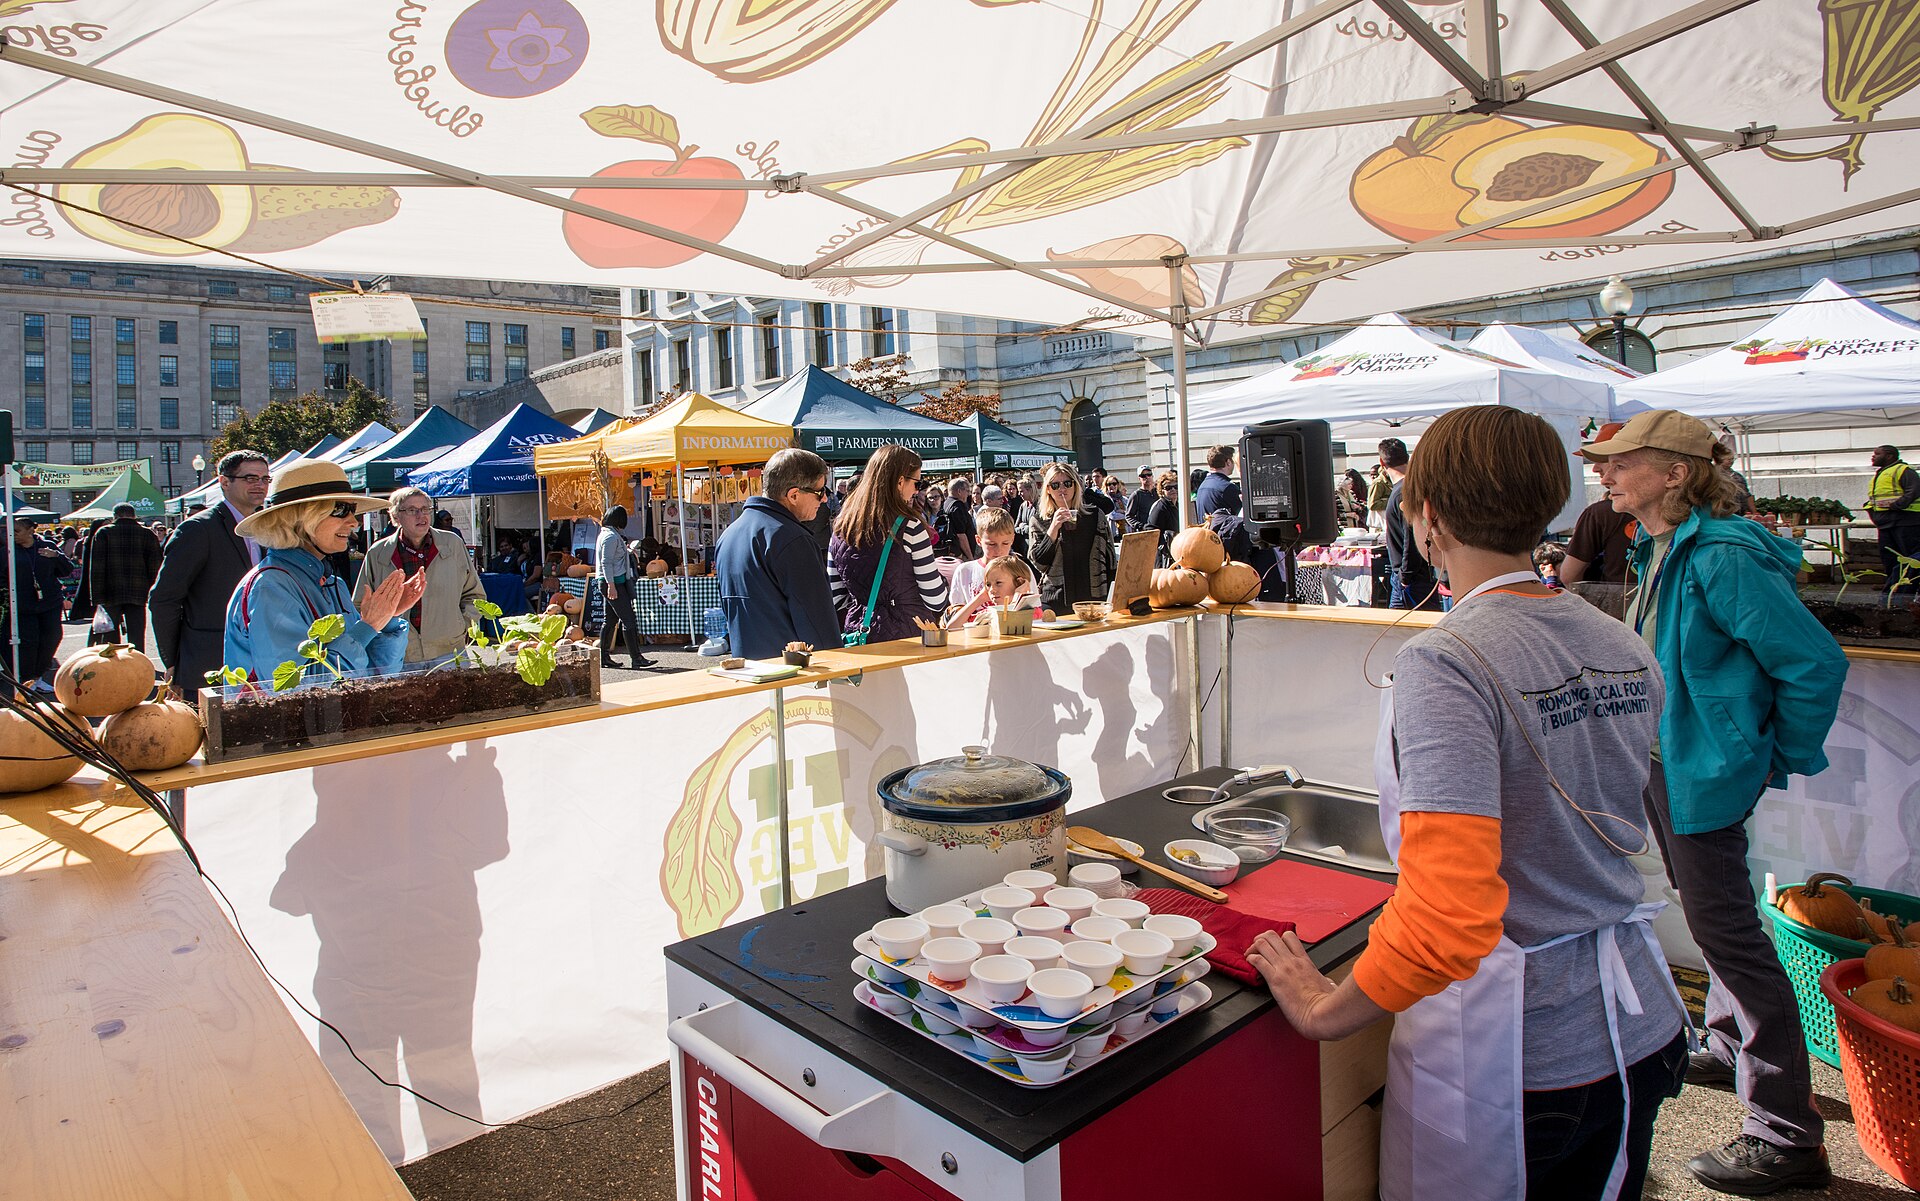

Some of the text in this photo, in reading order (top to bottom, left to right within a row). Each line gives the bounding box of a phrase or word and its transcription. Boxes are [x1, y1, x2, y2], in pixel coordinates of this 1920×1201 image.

[1815, 339, 1920, 352] FARMERS
[1812, 345, 1916, 360] MARKET
[1341, 359, 1434, 376] MARKET
[1351, 355, 1439, 367] FARMERS
[682, 436, 790, 449] INFORMATION
[837, 437, 940, 449] FARMERS MARKET
[41, 477, 71, 486] MARKET
[697, 1076, 722, 1201] CHARL
